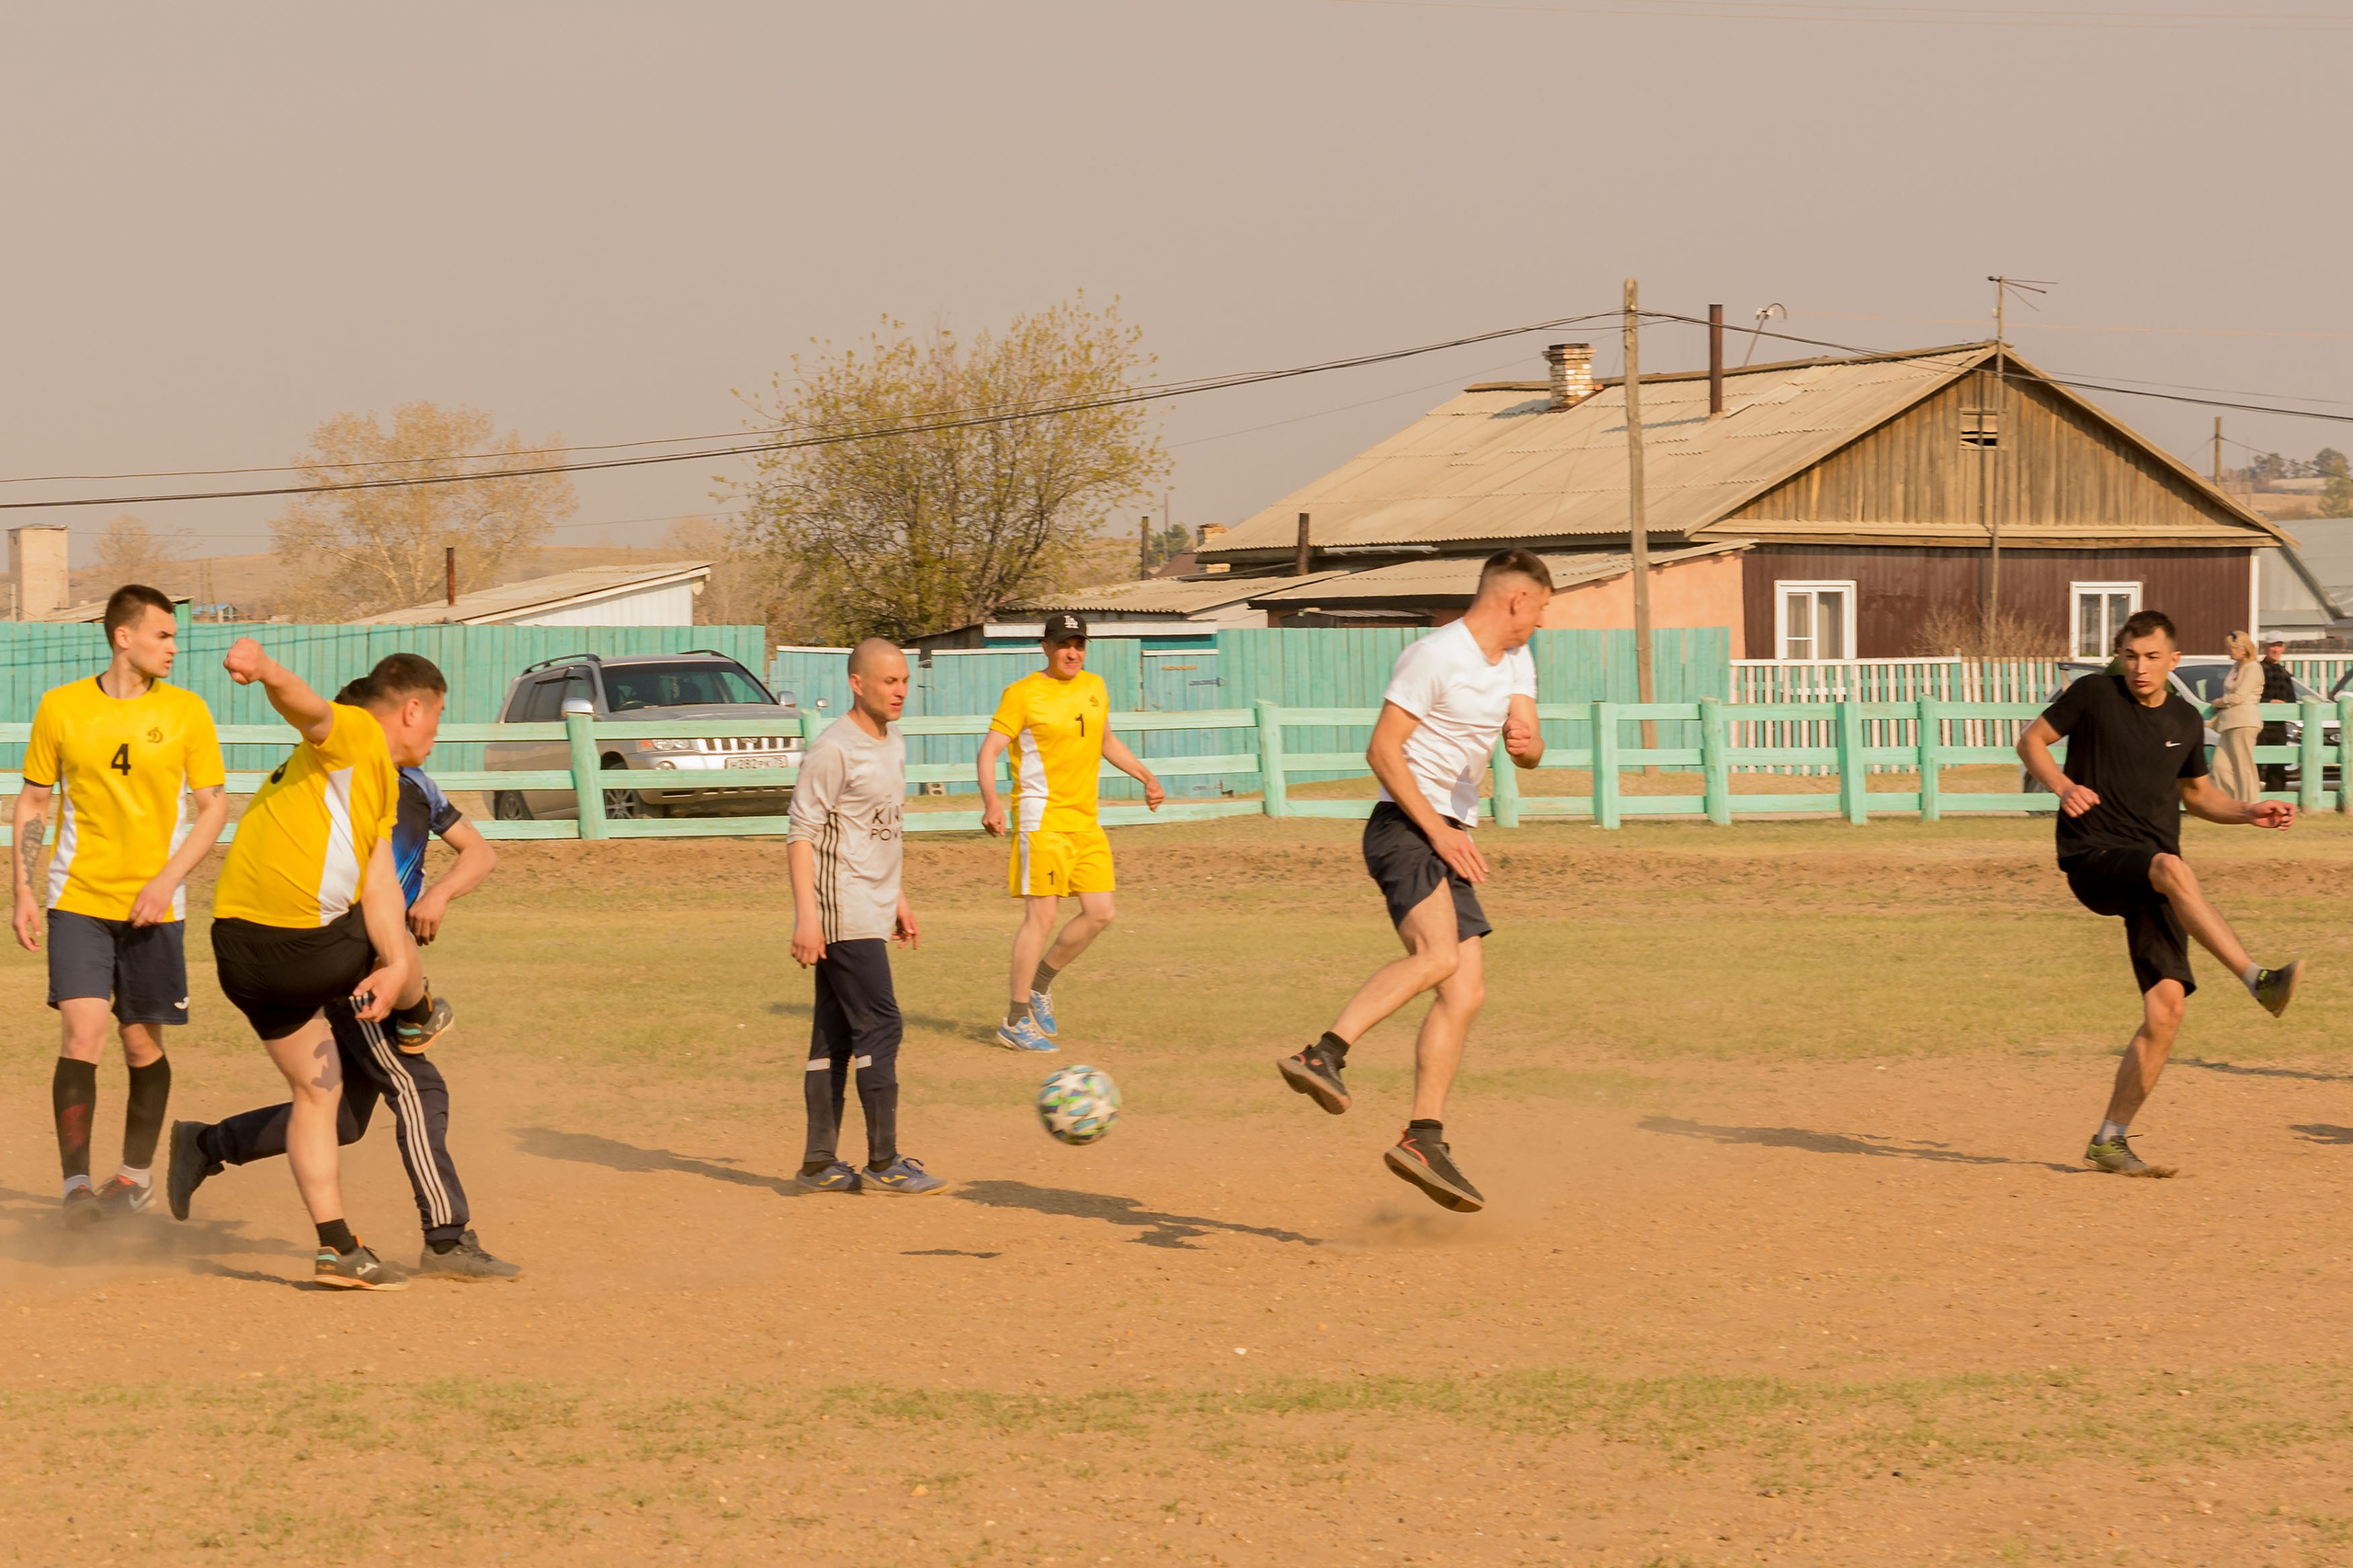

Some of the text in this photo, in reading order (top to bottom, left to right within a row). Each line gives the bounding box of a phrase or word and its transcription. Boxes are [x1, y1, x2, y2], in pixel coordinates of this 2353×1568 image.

[1075, 713, 1085, 737] 1
[110, 743, 131, 776] 4
[871, 803, 904, 825] KIN
[1047, 869, 1054, 885] 1
